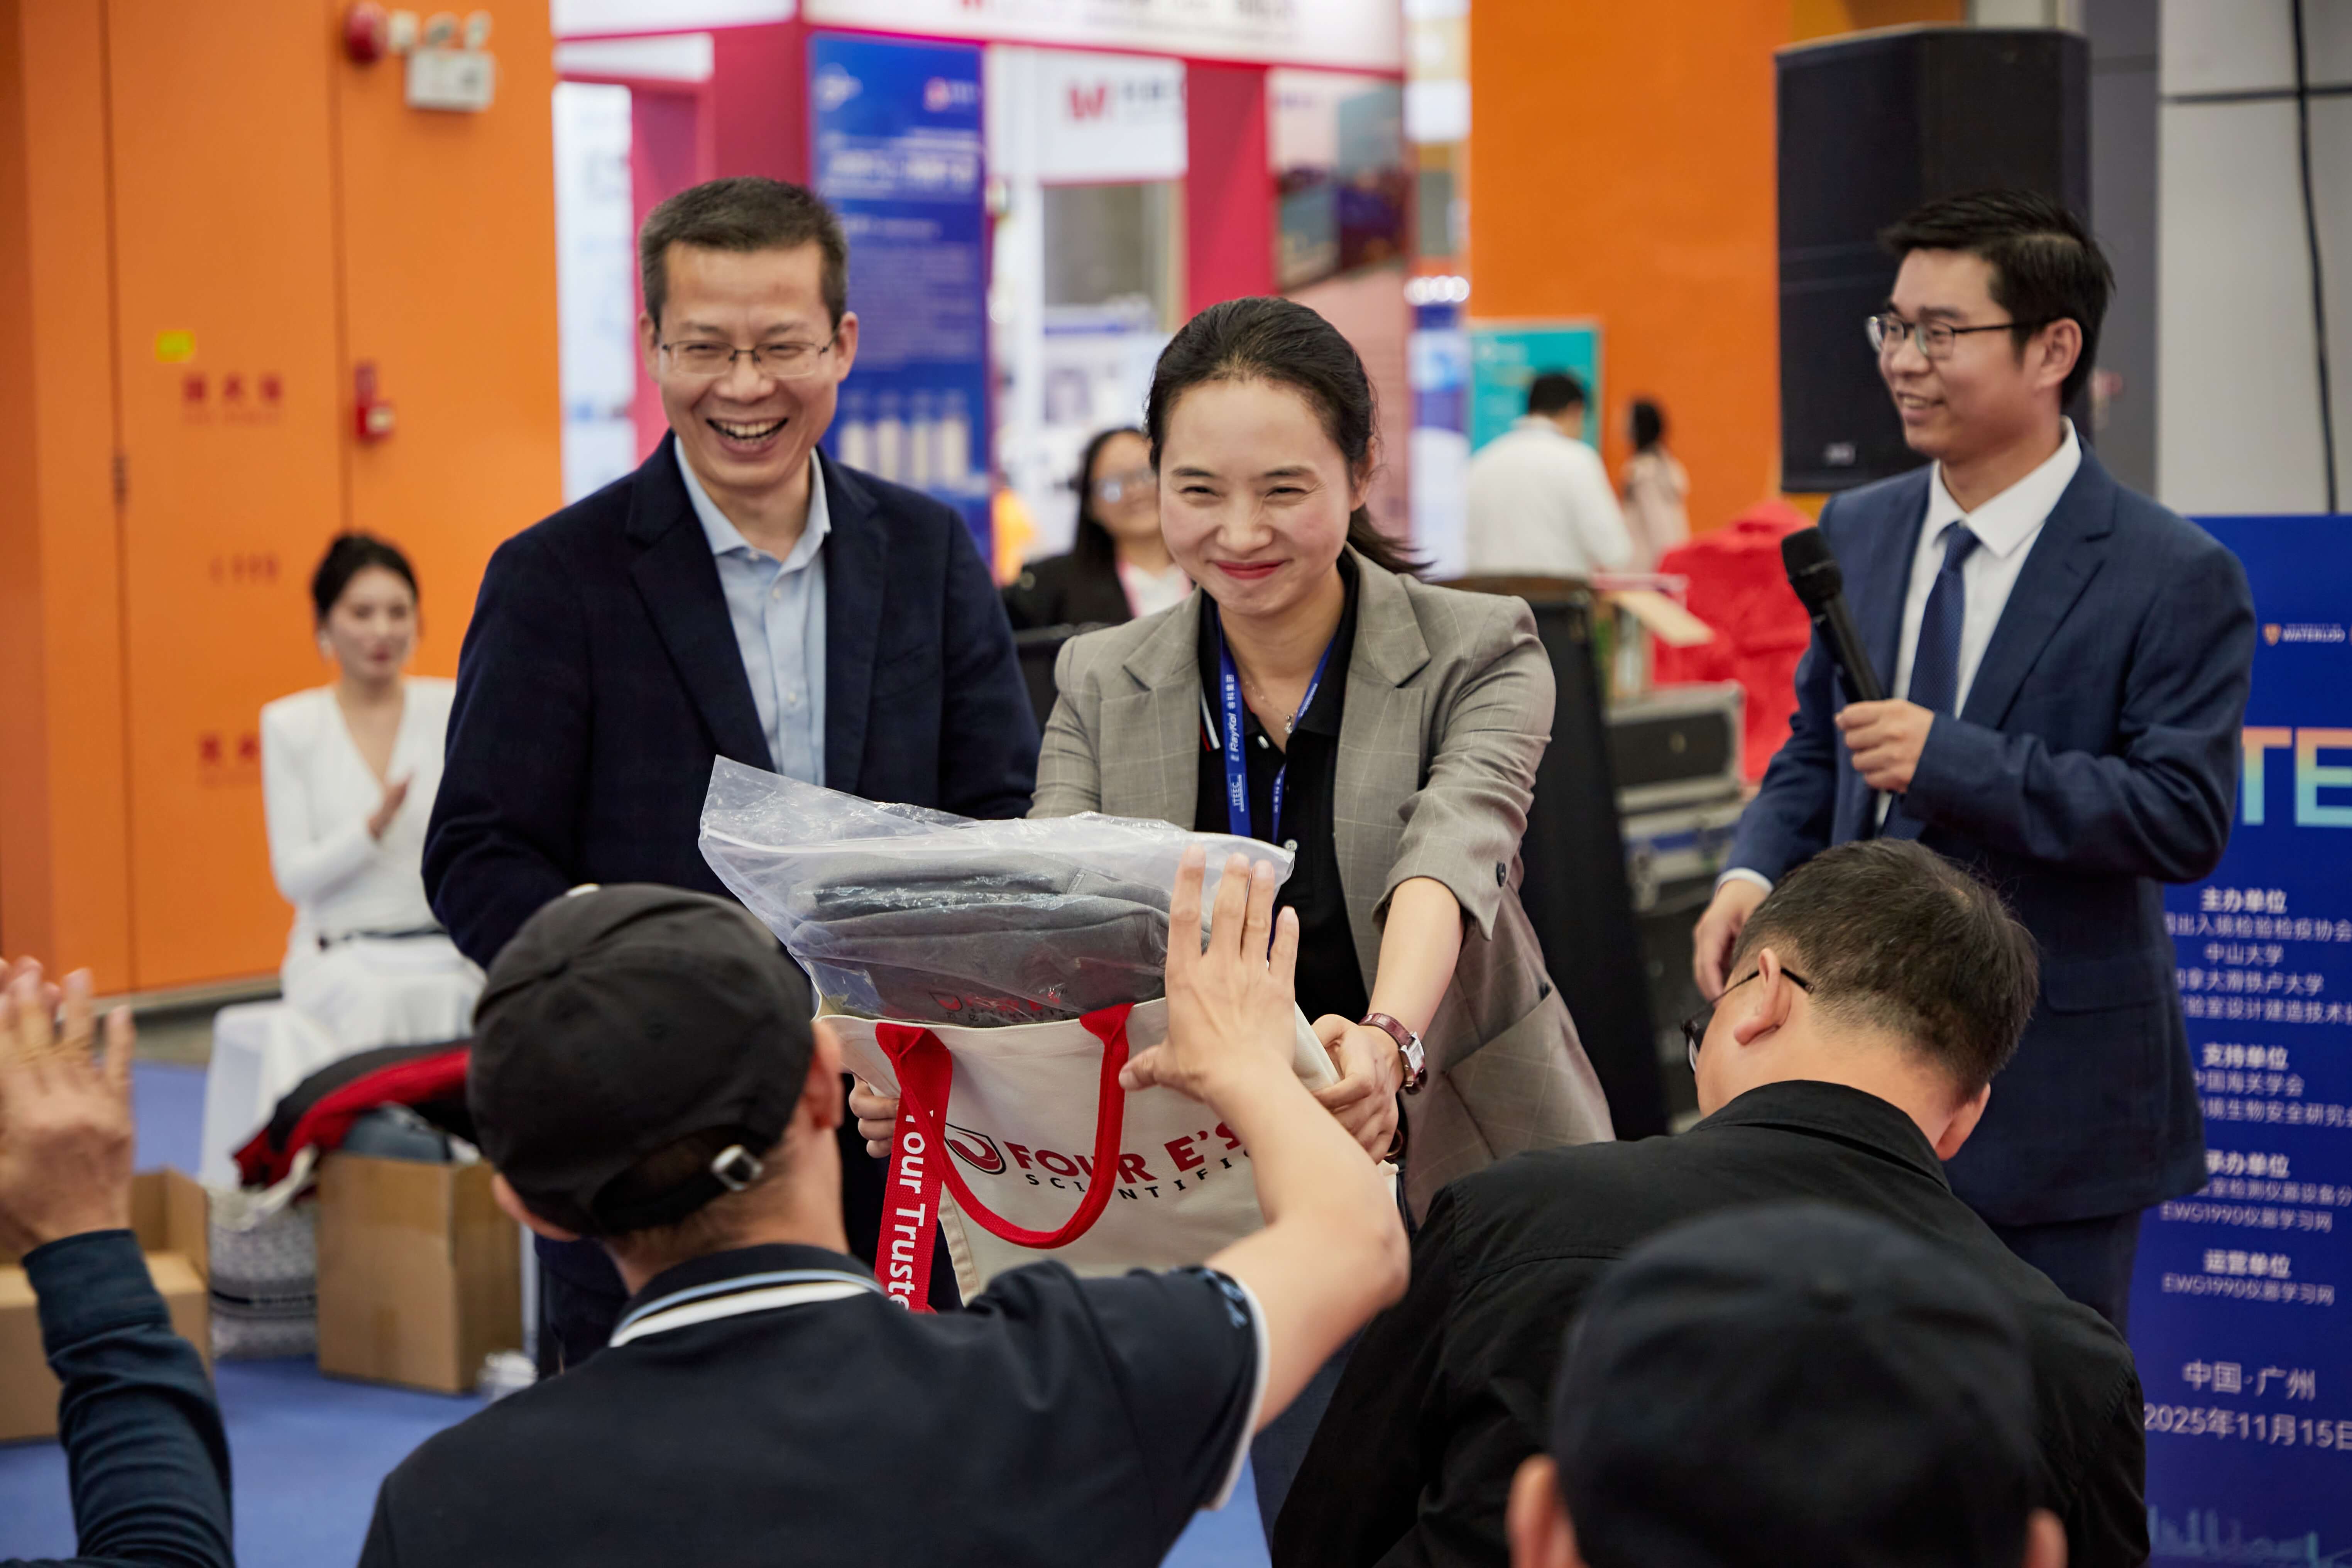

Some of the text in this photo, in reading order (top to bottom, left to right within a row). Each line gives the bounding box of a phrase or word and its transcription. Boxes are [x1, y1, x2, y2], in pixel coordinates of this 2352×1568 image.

[2283, 628, 2346, 643] WATERLOO
[2202, 886, 2287, 913] 主办单位
[2204, 942, 2284, 967] 中山大学
[2203, 1041, 2289, 1071] 支持单位
[899, 1110, 934, 1194] our
[2205, 1149, 2290, 1178] 承办单位
[1025, 1149, 1249, 1200] SCINTIFI
[2203, 1248, 2291, 1279] 运营单位
[2182, 1359, 2315, 1401] 中国·广州
[2144, 1402, 2352, 1450] 2025年11月15日
